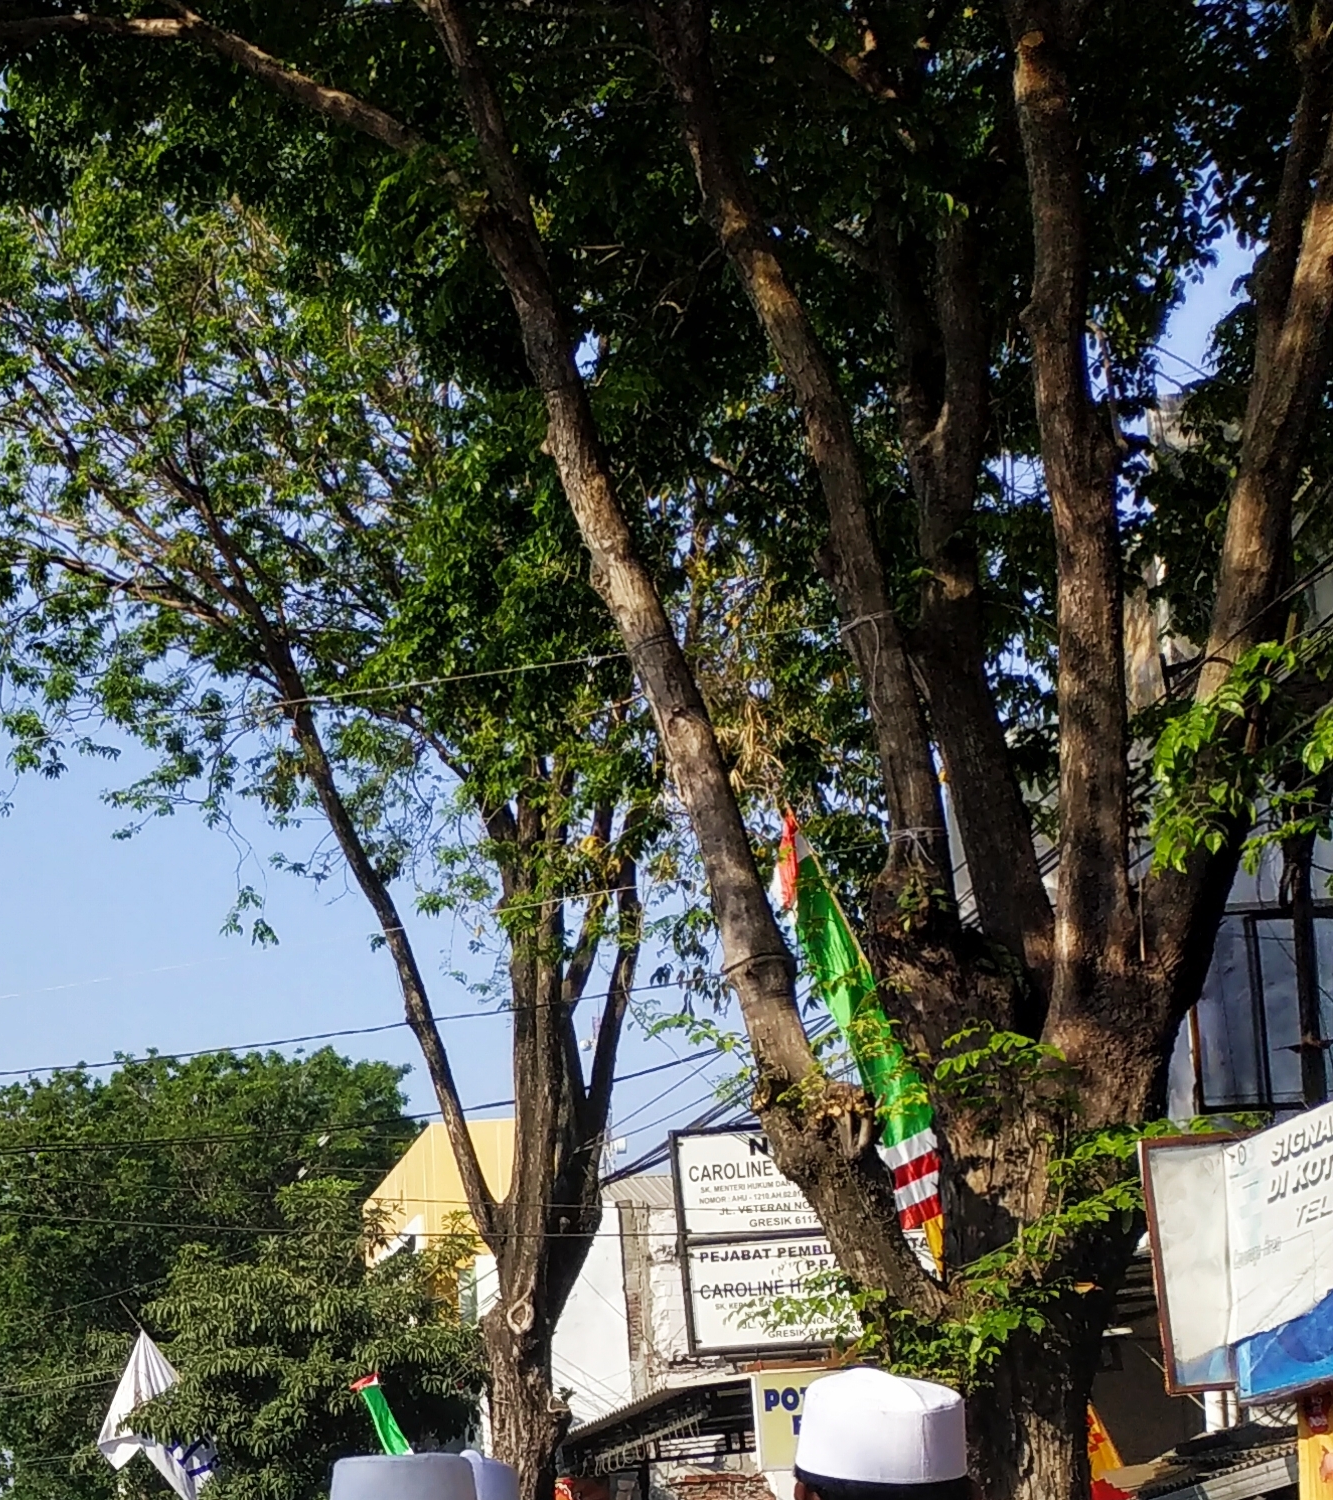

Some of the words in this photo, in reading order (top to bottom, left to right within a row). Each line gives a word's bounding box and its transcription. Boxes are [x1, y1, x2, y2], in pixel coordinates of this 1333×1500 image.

[1271, 1116, 1333, 1167] SIGNA
[688, 1160, 773, 1182] CAROLINE
[714, 1184, 745, 1192] MENTERI
[747, 1182, 774, 1190] HUKUM
[738, 1202, 791, 1214] VETERAN
[749, 1216, 792, 1227] GRESIK
[795, 1214, 819, 1225] 6112
[700, 1248, 771, 1263] PEJABAT
[777, 1243, 832, 1258] PEMBU
[700, 1281, 784, 1300] CAROLINE
[767, 1327, 805, 1338] GRESIK
